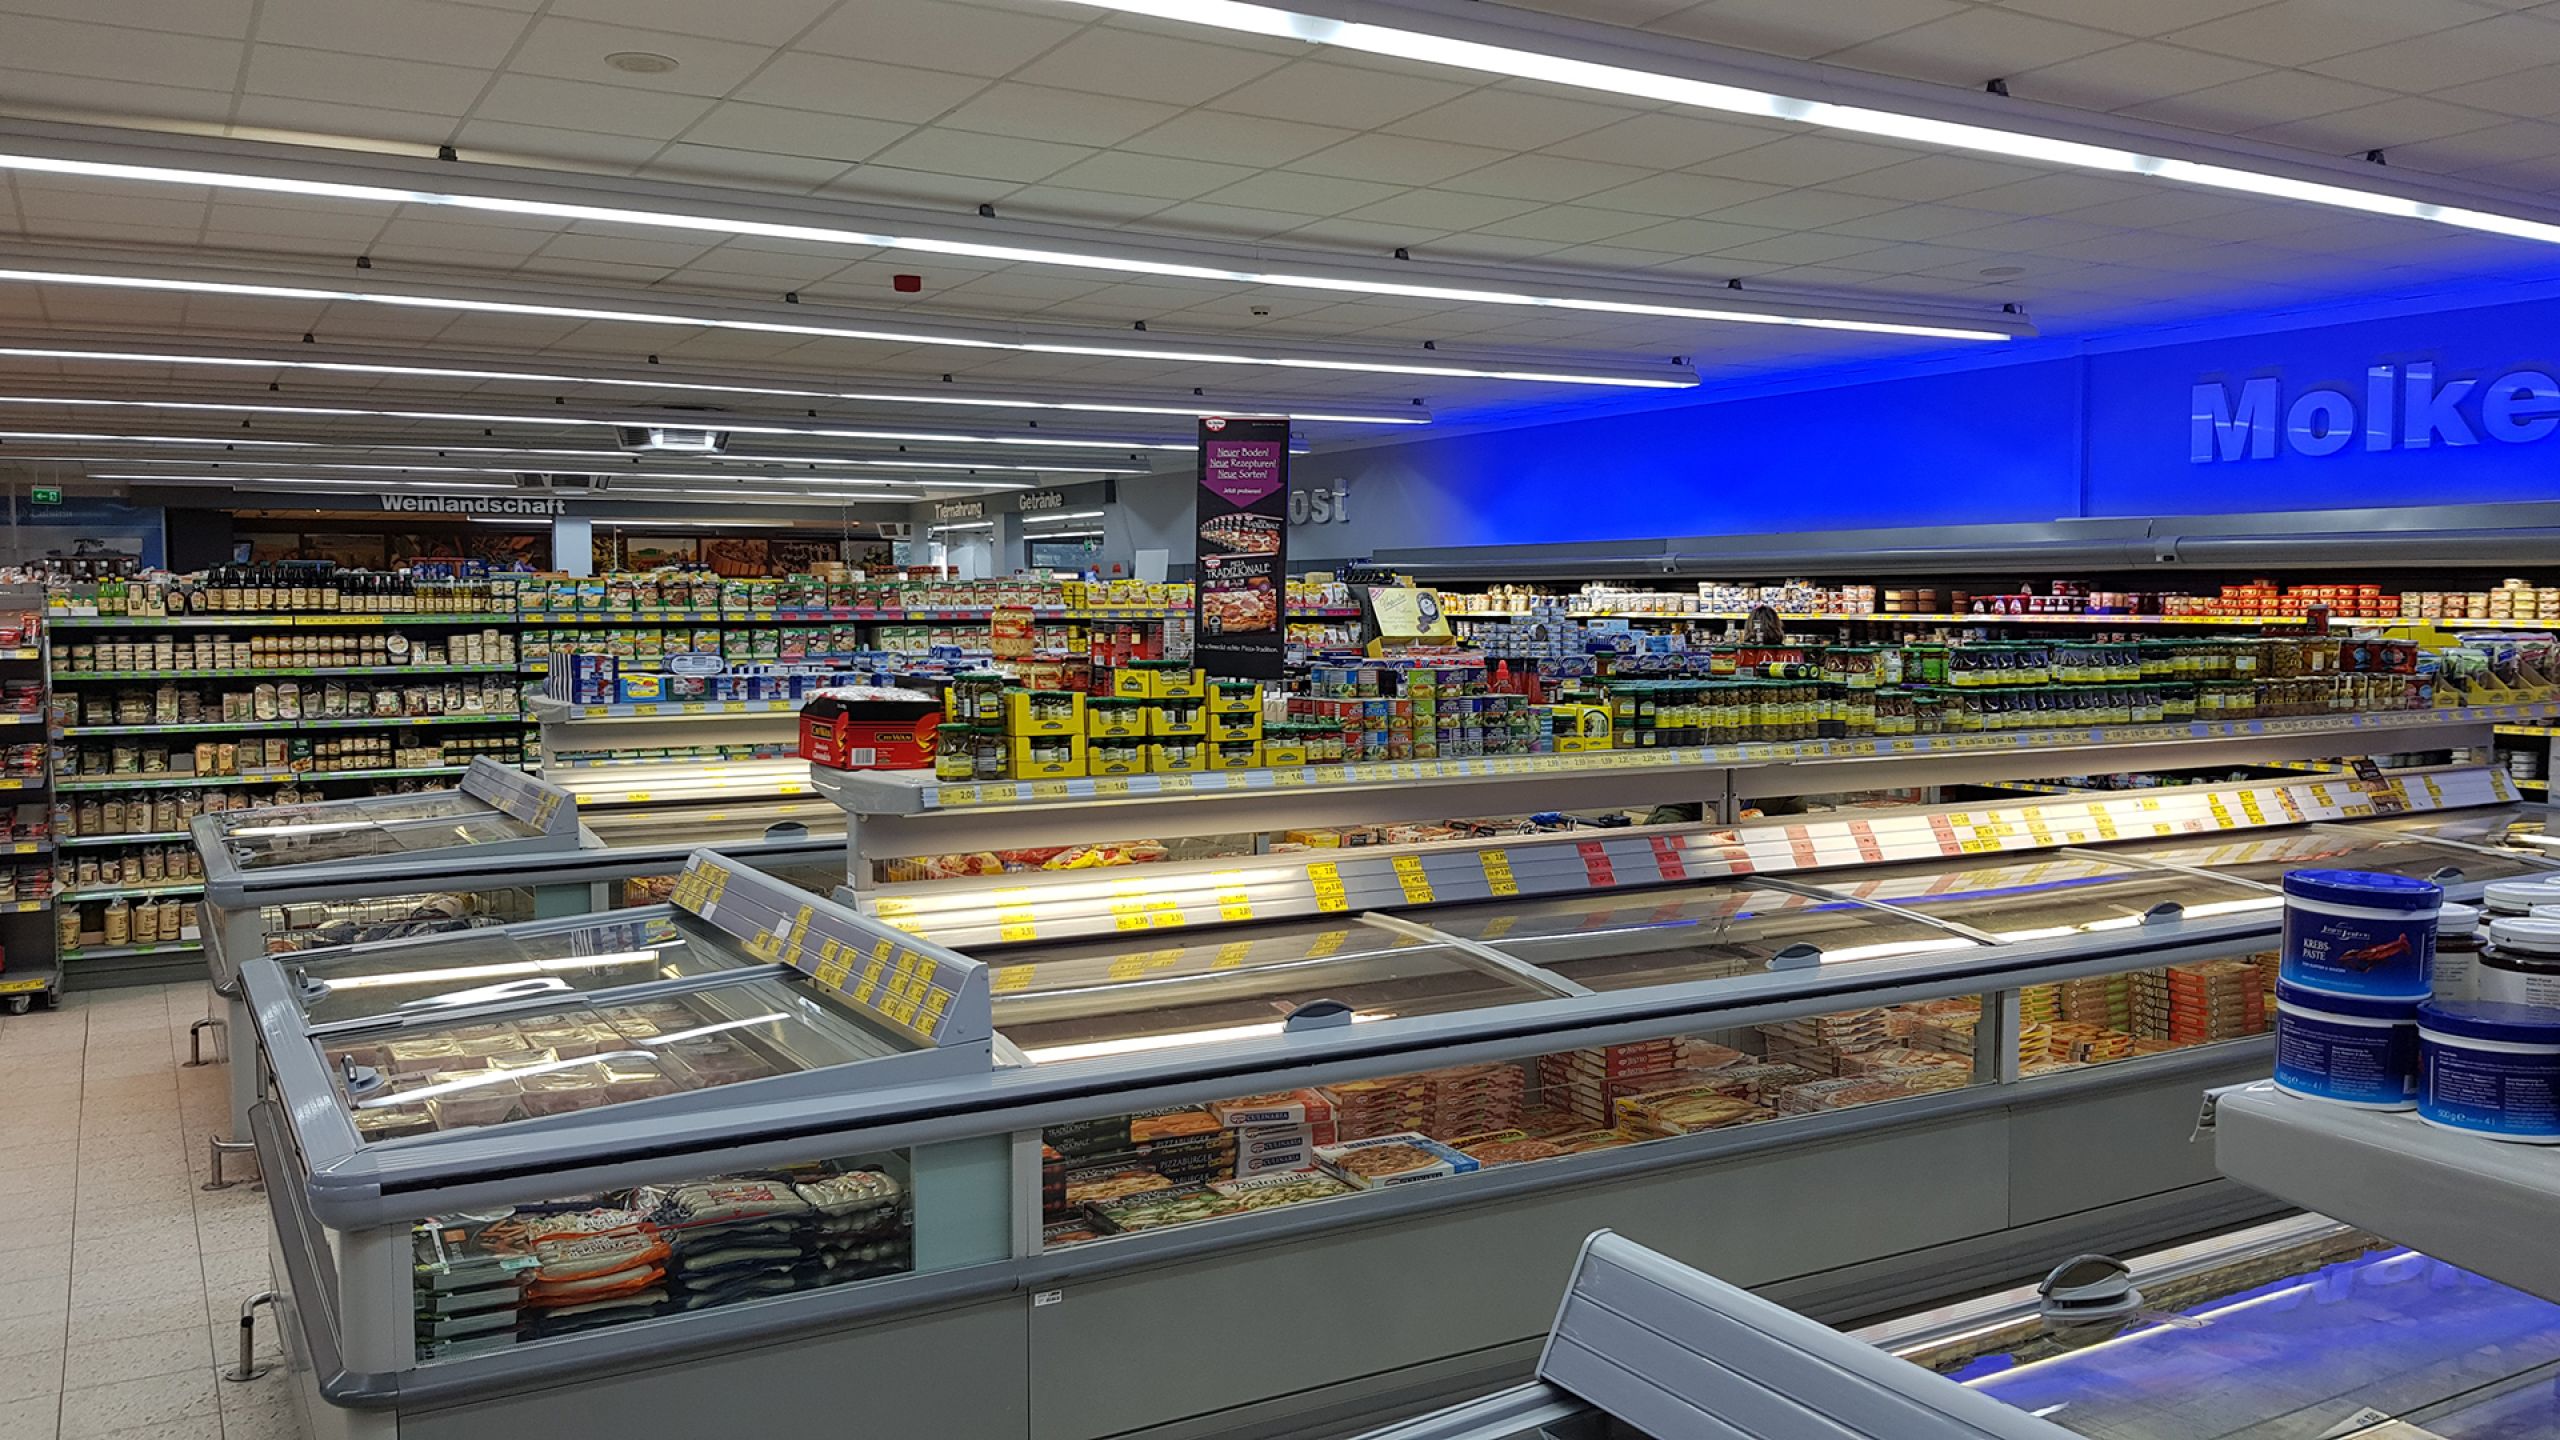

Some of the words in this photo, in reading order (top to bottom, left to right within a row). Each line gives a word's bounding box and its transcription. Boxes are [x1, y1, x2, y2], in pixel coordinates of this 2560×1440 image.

[2190, 361, 2560, 463] Molke
[1217, 447, 1240, 458] Neuer
[1241, 447, 1269, 457] Boden!
[1209, 458, 1229, 469] Neue
[1231, 458, 1277, 470] Rezepturen!
[1217, 470, 1238, 480] Neue
[1239, 470, 1268, 479] Sorten!
[380, 494, 566, 515] Weinlandschaft
[1019, 492, 1062, 511] Getränke
[935, 501, 983, 519] Tiernahrung
[1206, 563, 1272, 579] TRADIZIONALE
[960, 790, 976, 800] 2,09
[2303, 938, 2331, 951] KREBS-
[2303, 948, 2326, 961] PASTE
[1159, 1153, 1212, 1169] PIZZABURGER
